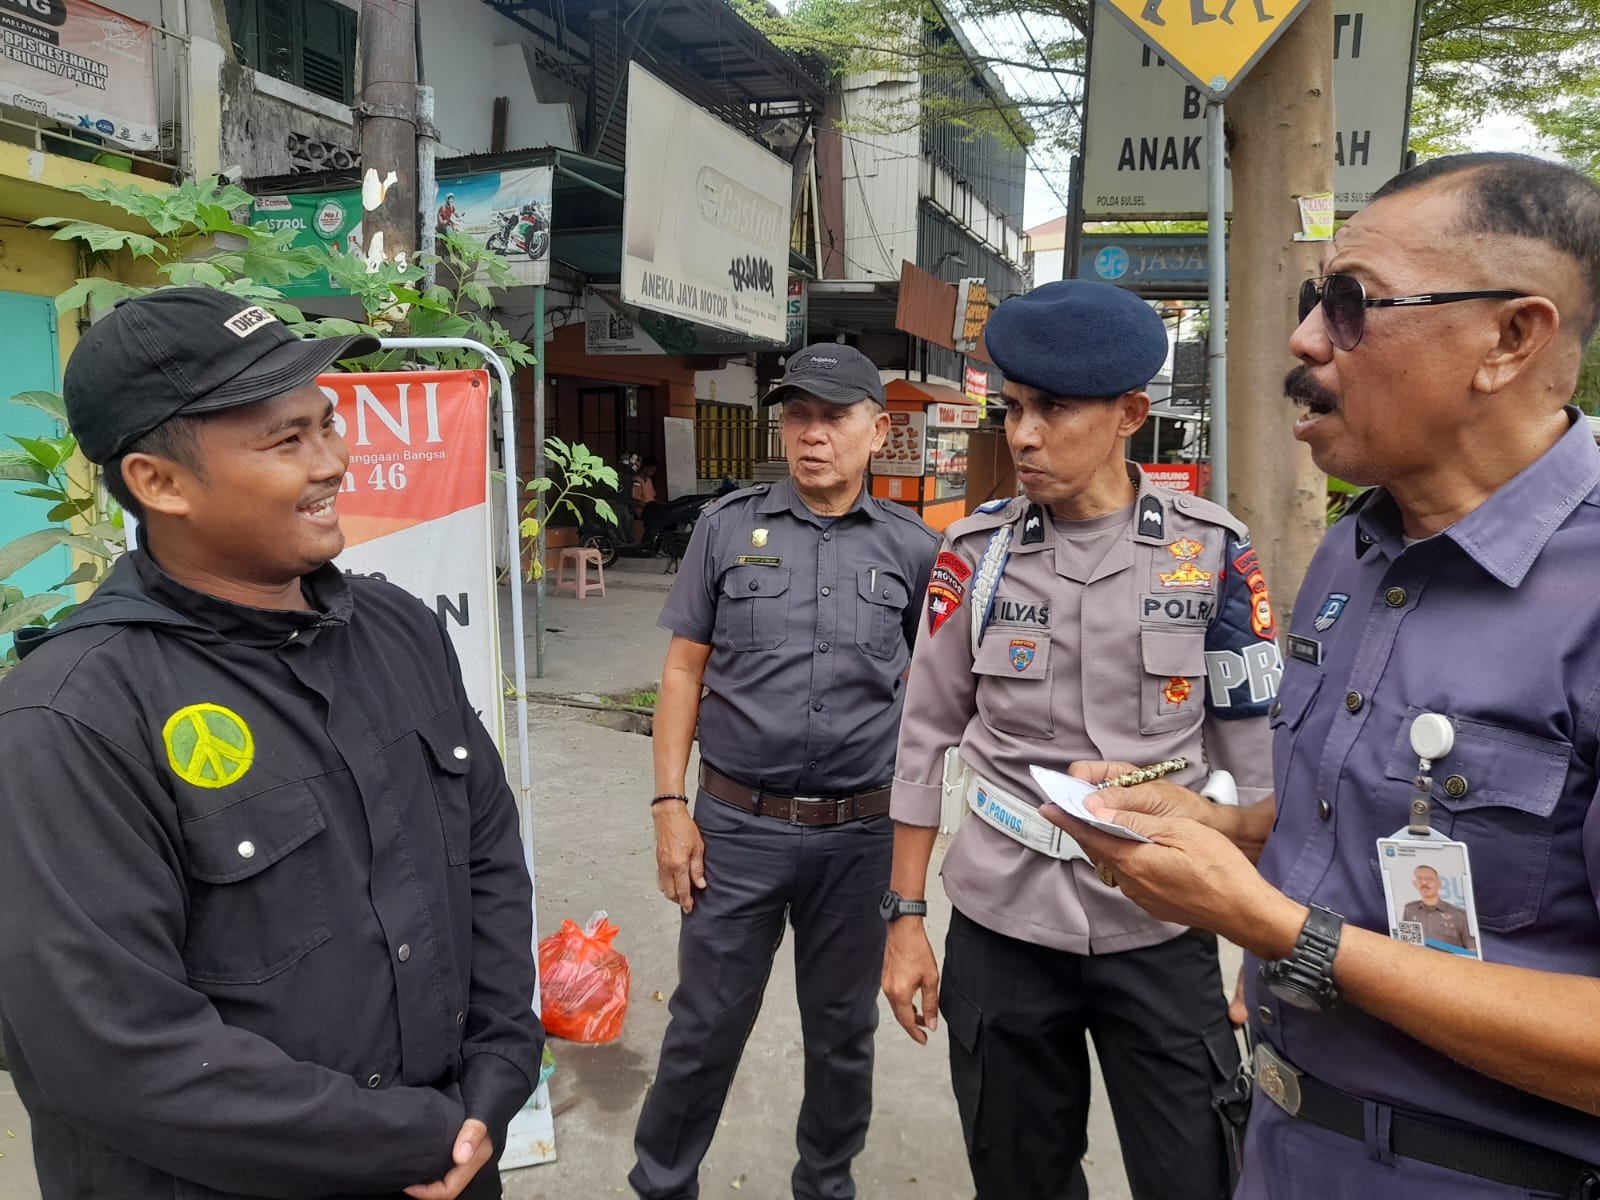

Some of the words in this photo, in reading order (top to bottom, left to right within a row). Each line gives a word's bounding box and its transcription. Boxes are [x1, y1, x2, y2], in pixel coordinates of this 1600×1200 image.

[2, 16, 50, 39] MELAYANI
[4, 45, 57, 75] EBILING
[66, 64, 106, 91] PAJAK
[37, 41, 109, 78] KESEHATAN
[1117, 136, 1202, 171] ANAK
[1097, 196, 1119, 207] POLDA
[1120, 196, 1146, 207] SULSEL
[1334, 192, 1350, 203] HUB
[268, 217, 307, 231] STROL
[1134, 246, 1206, 275] JASA
[641, 271, 675, 304] ANEKA
[677, 282, 698, 311] JAYA
[700, 290, 729, 319] MOTOR
[349, 455, 400, 465] anggaan
[403, 450, 446, 462] Bangsa
[367, 462, 408, 492] 46
[932, 570, 963, 594] PROVOS
[1000, 602, 1050, 625] ILYAS
[1144, 598, 1215, 621] POLRI
[989, 802, 1023, 834] PROVOS
